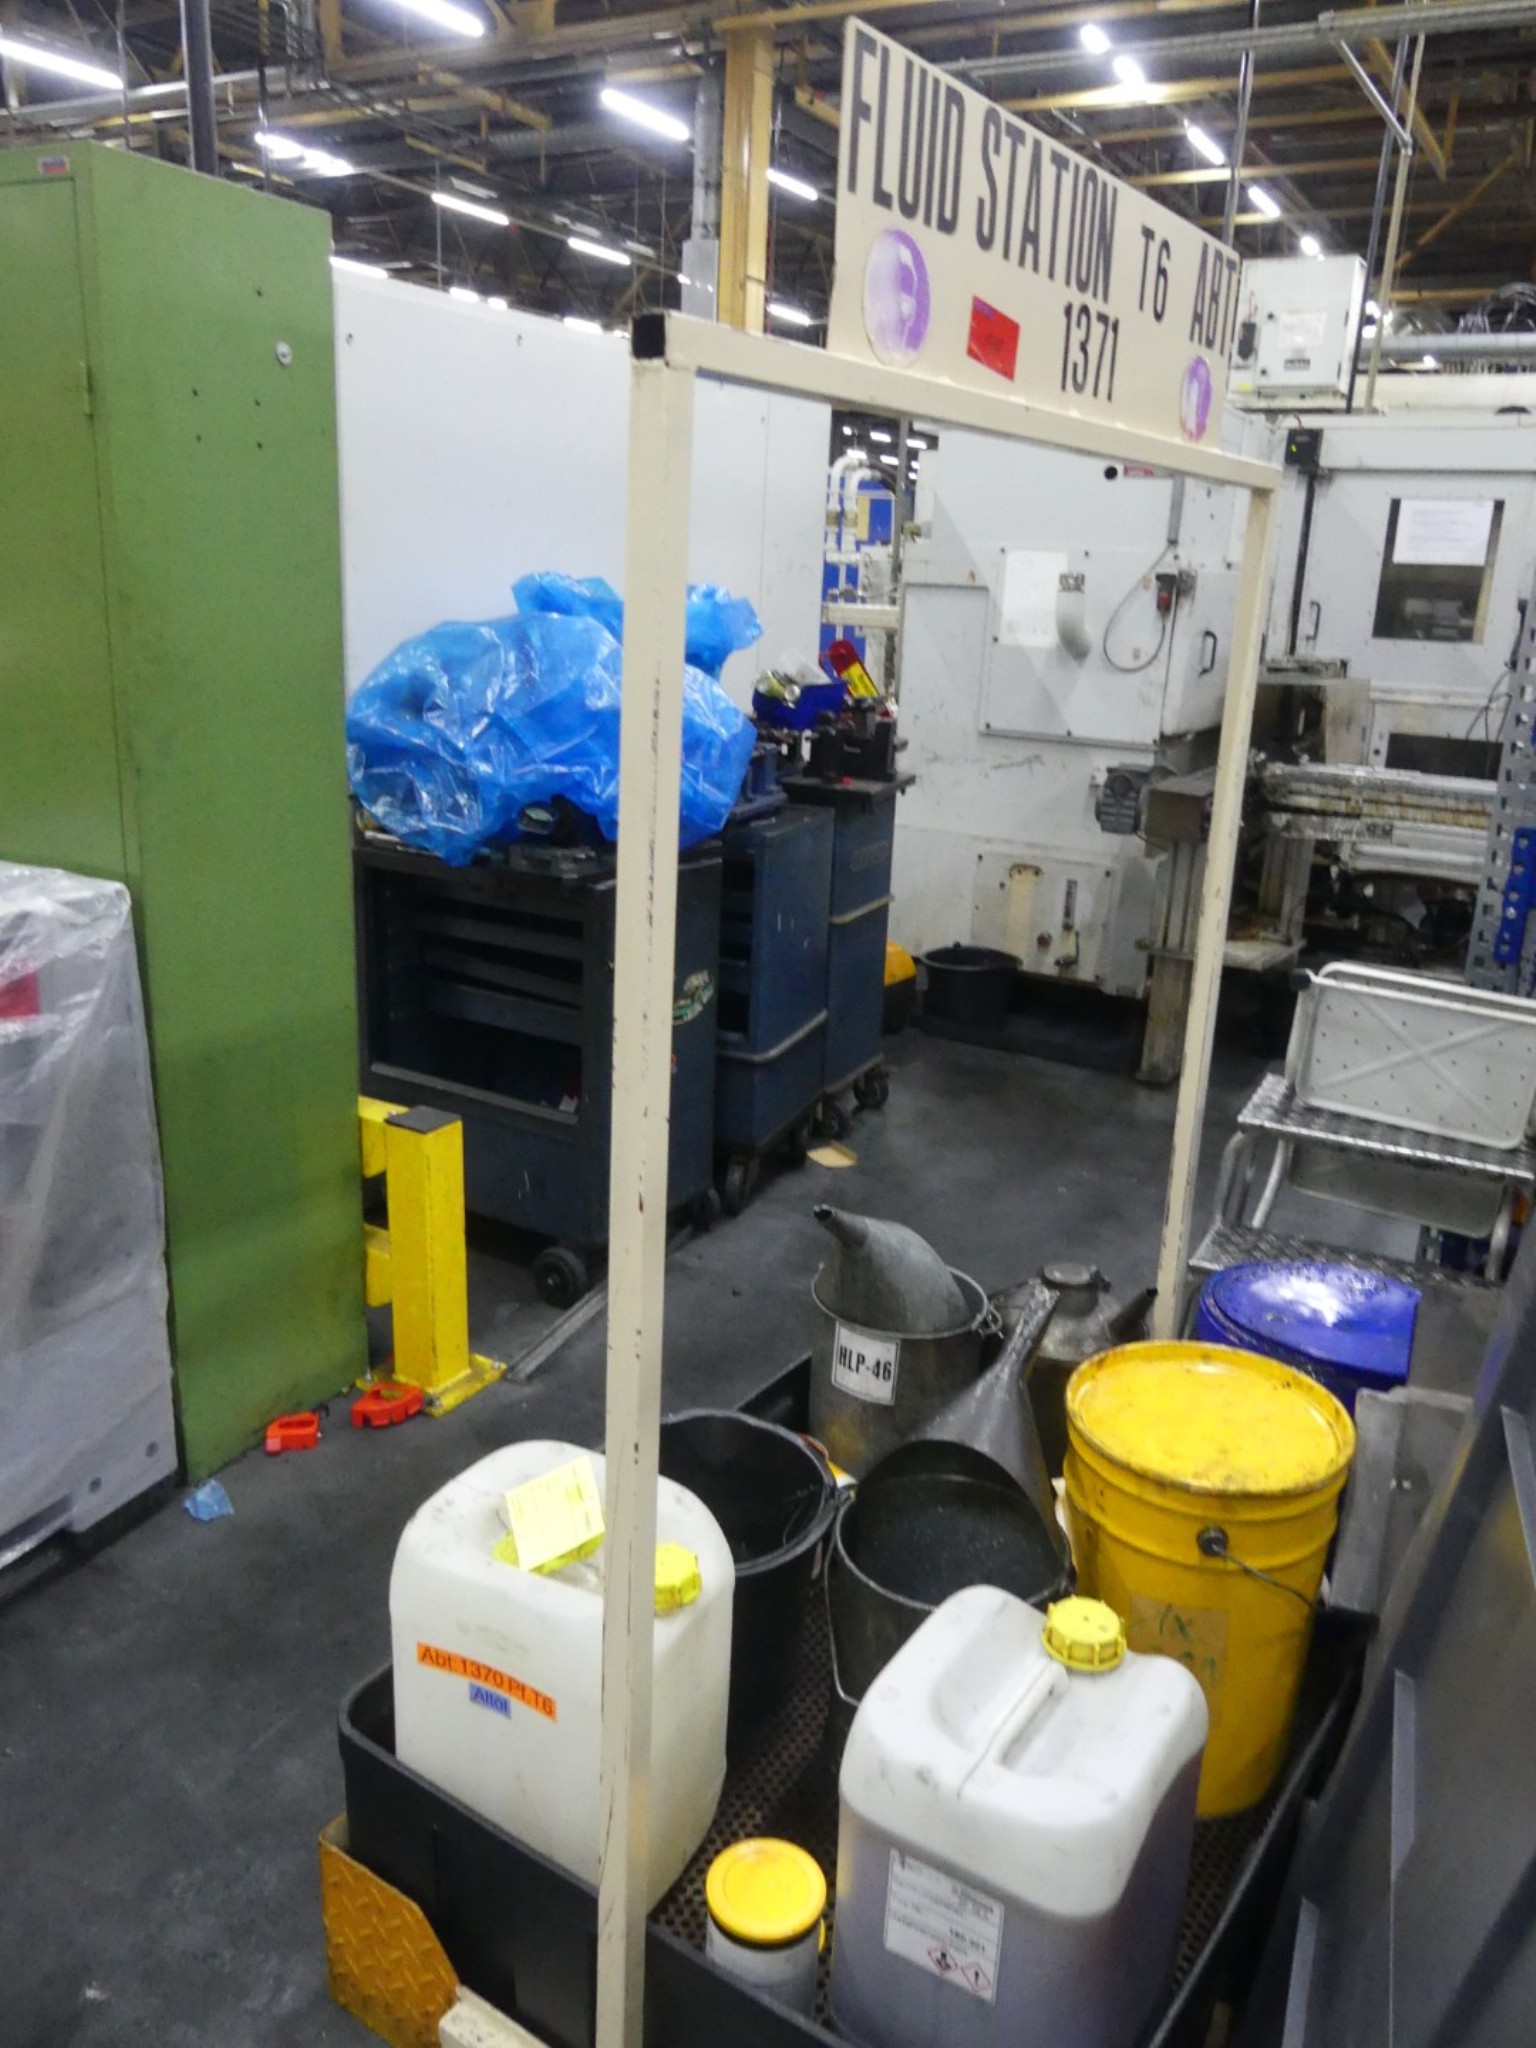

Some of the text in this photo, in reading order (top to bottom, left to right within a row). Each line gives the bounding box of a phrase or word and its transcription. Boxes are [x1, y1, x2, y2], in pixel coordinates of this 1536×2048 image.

[847, 29, 965, 236] FLUID
[976, 108, 1118, 304] STATION
[1139, 225, 1171, 322] T6
[1061, 301, 1120, 402] 1371
[839, 1344, 892, 1382] HLP-46
[461, 1657, 504, 1689] 1370
